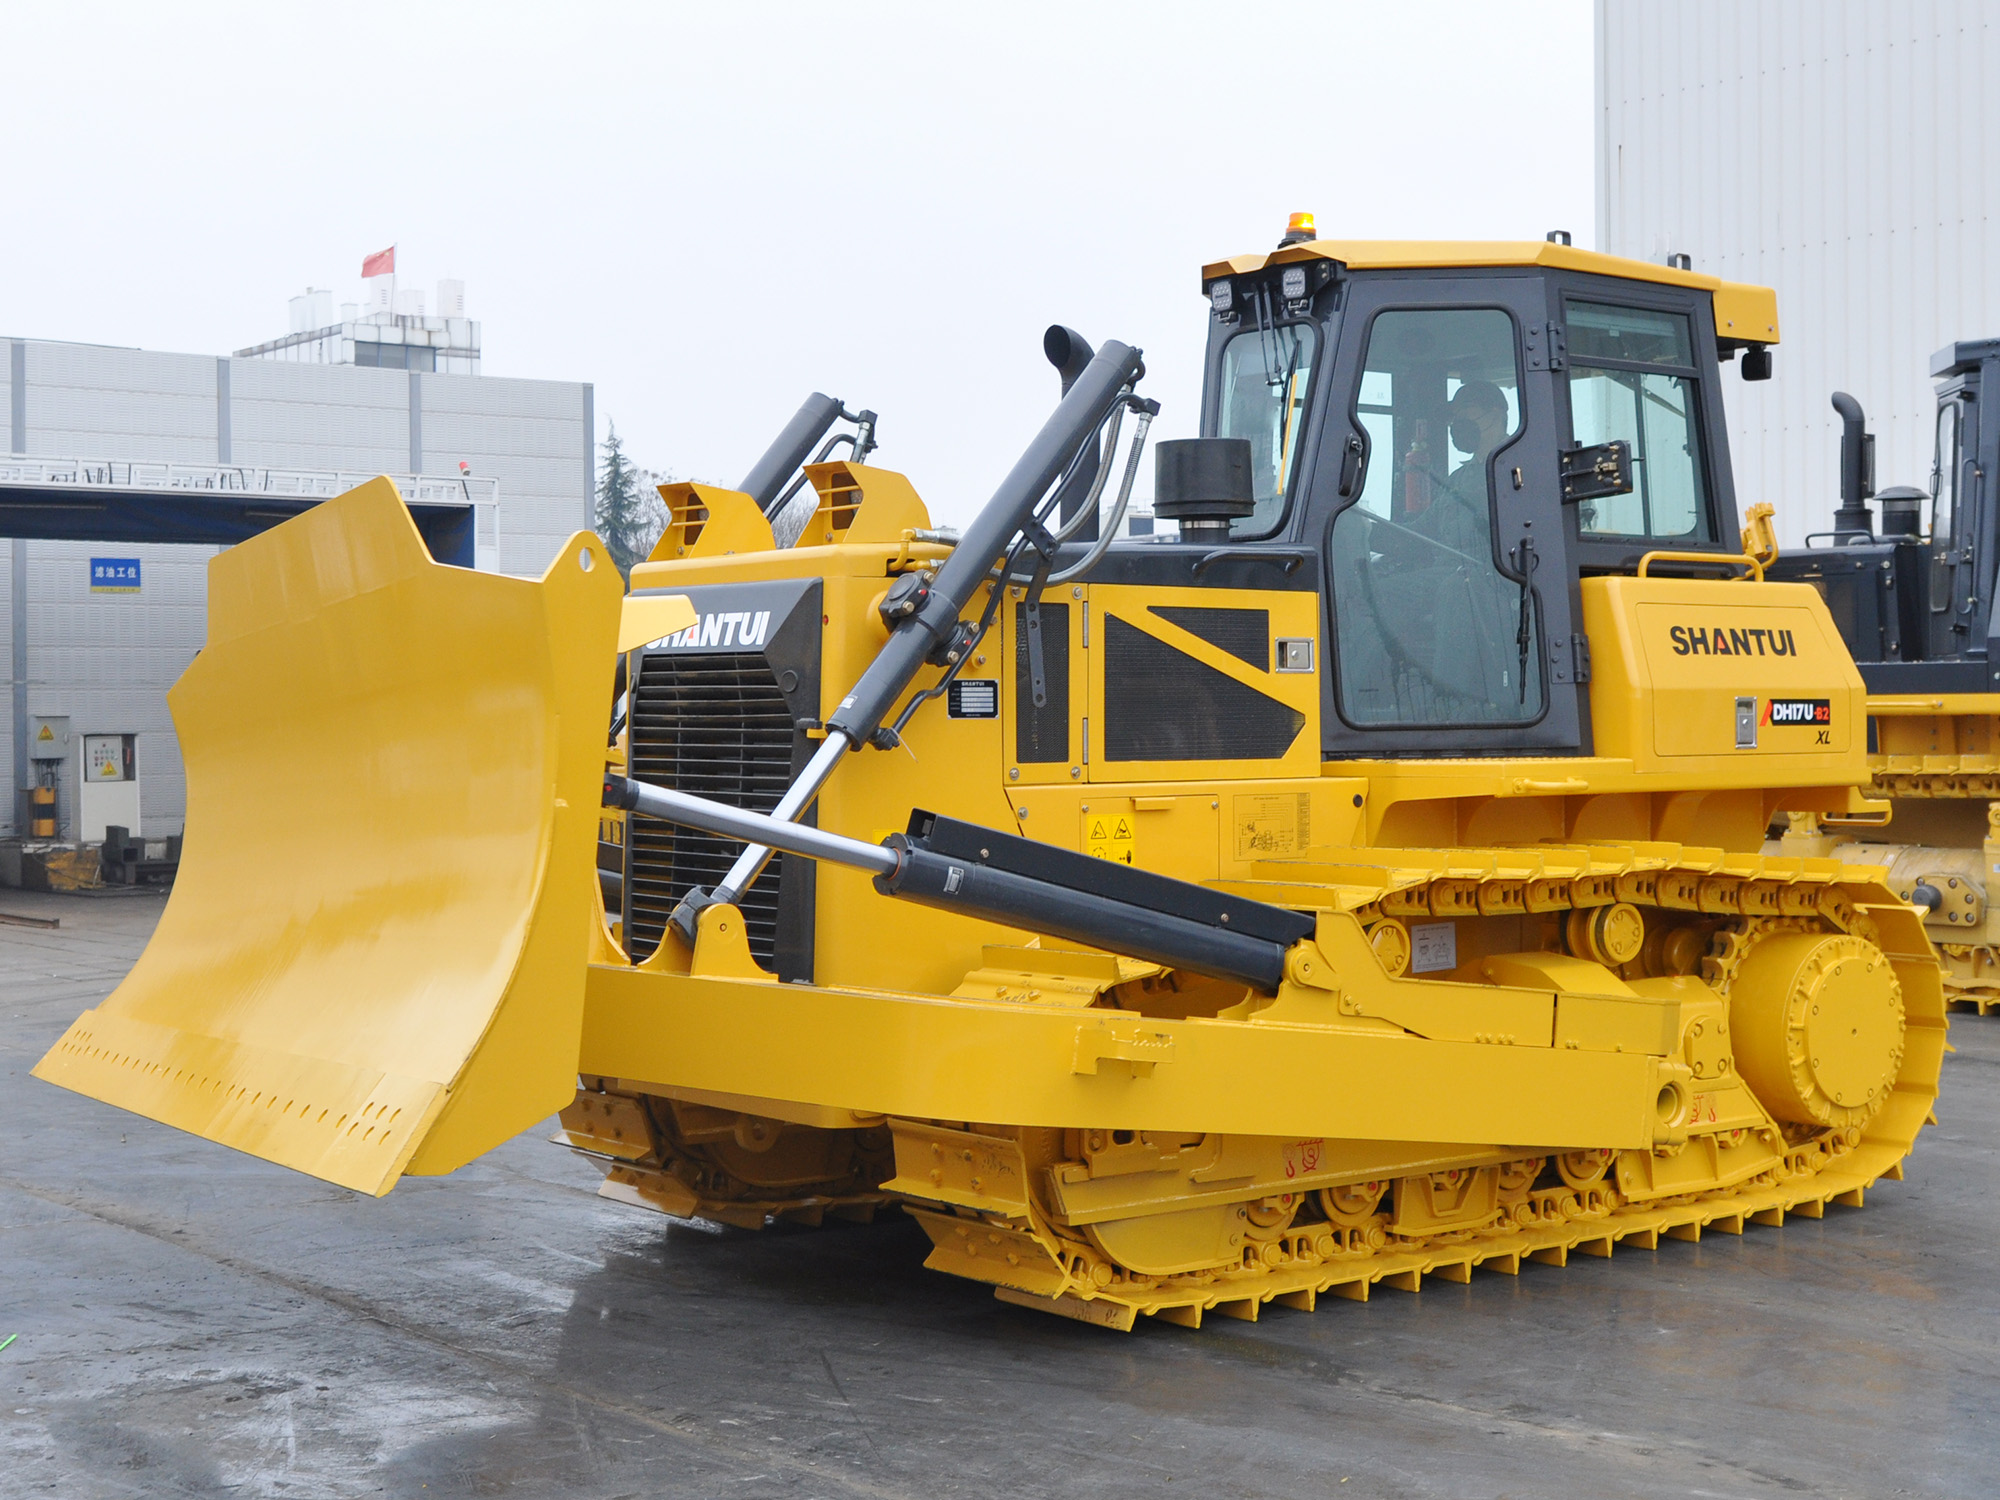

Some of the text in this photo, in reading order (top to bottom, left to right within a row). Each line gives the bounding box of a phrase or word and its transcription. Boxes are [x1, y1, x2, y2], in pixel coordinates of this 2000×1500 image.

[95, 566, 136, 578] 滤油工位
[646, 611, 770, 649] ANTUI
[1670, 626, 1797, 656] SHANTUI
[1773, 703, 1829, 720] DH17U-B2
[1815, 730, 1831, 744] XL
